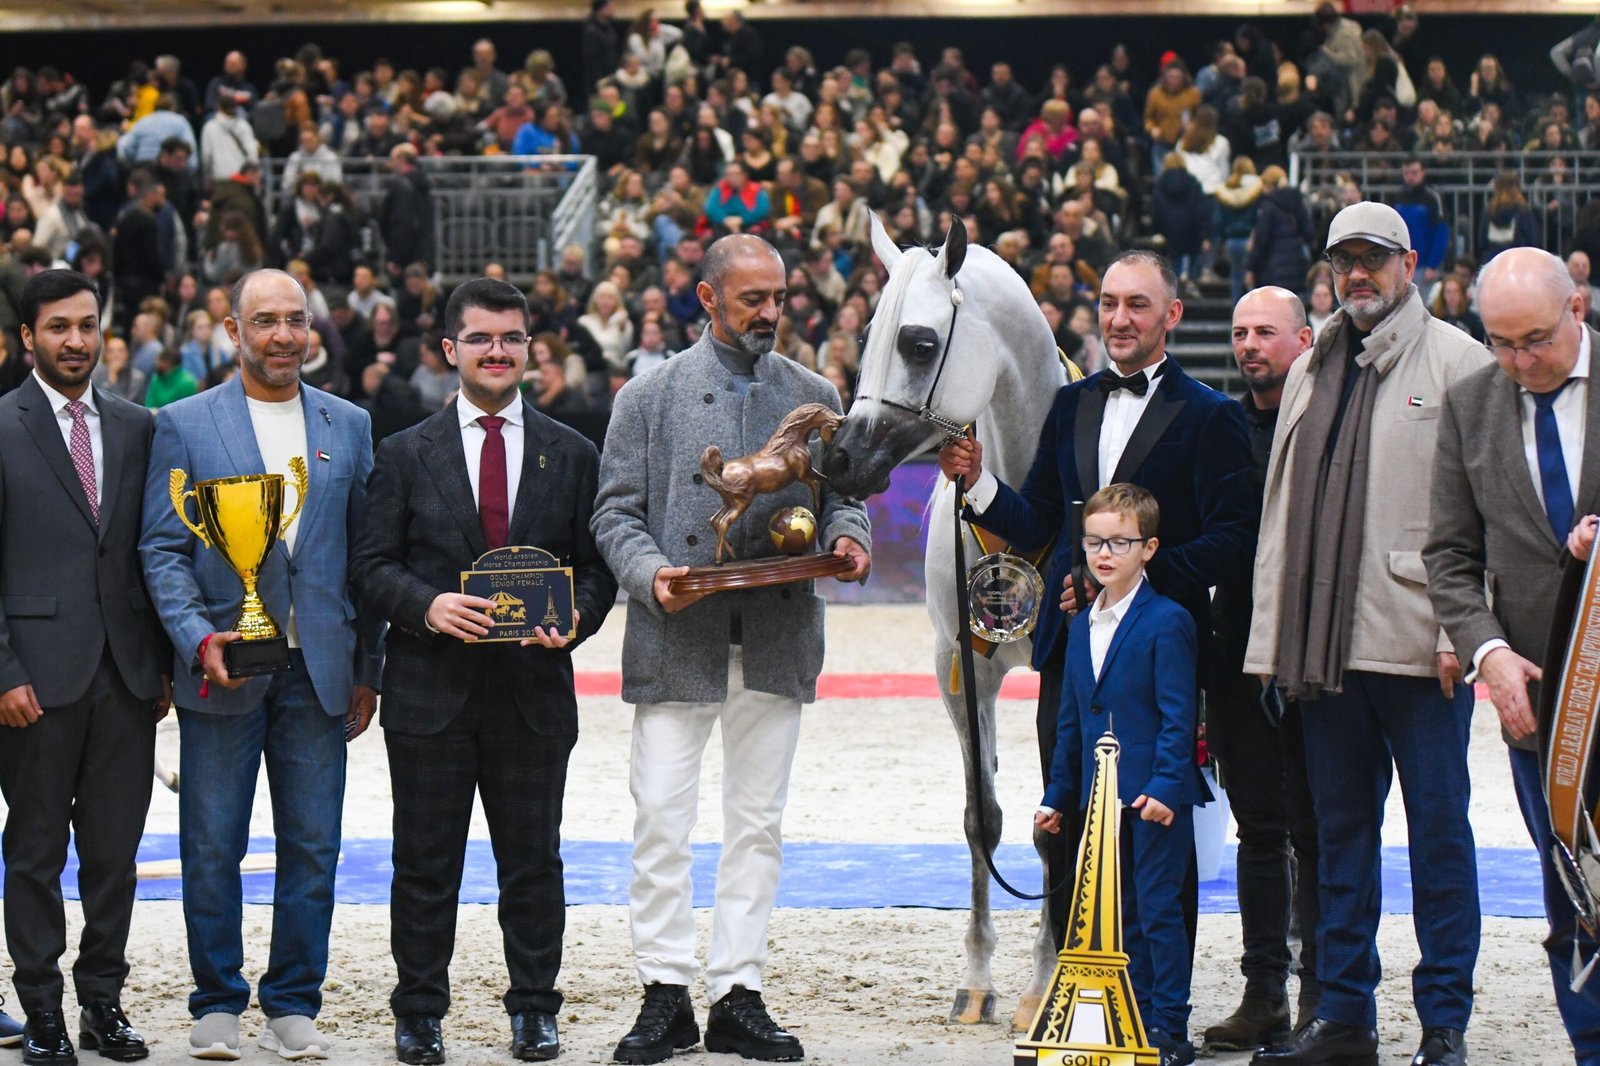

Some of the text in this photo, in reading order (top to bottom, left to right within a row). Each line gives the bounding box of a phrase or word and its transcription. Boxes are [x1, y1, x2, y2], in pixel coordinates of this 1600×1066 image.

[504, 560, 549, 568] Championship
[517, 579, 544, 587] FEMALE
[499, 629, 519, 637] PARIS
[1567, 676, 1596, 712] HORSE
[1560, 709, 1587, 756] ARABIAN
[1555, 754, 1578, 786] WORLD
[1062, 1054, 1111, 1066] GOLD
